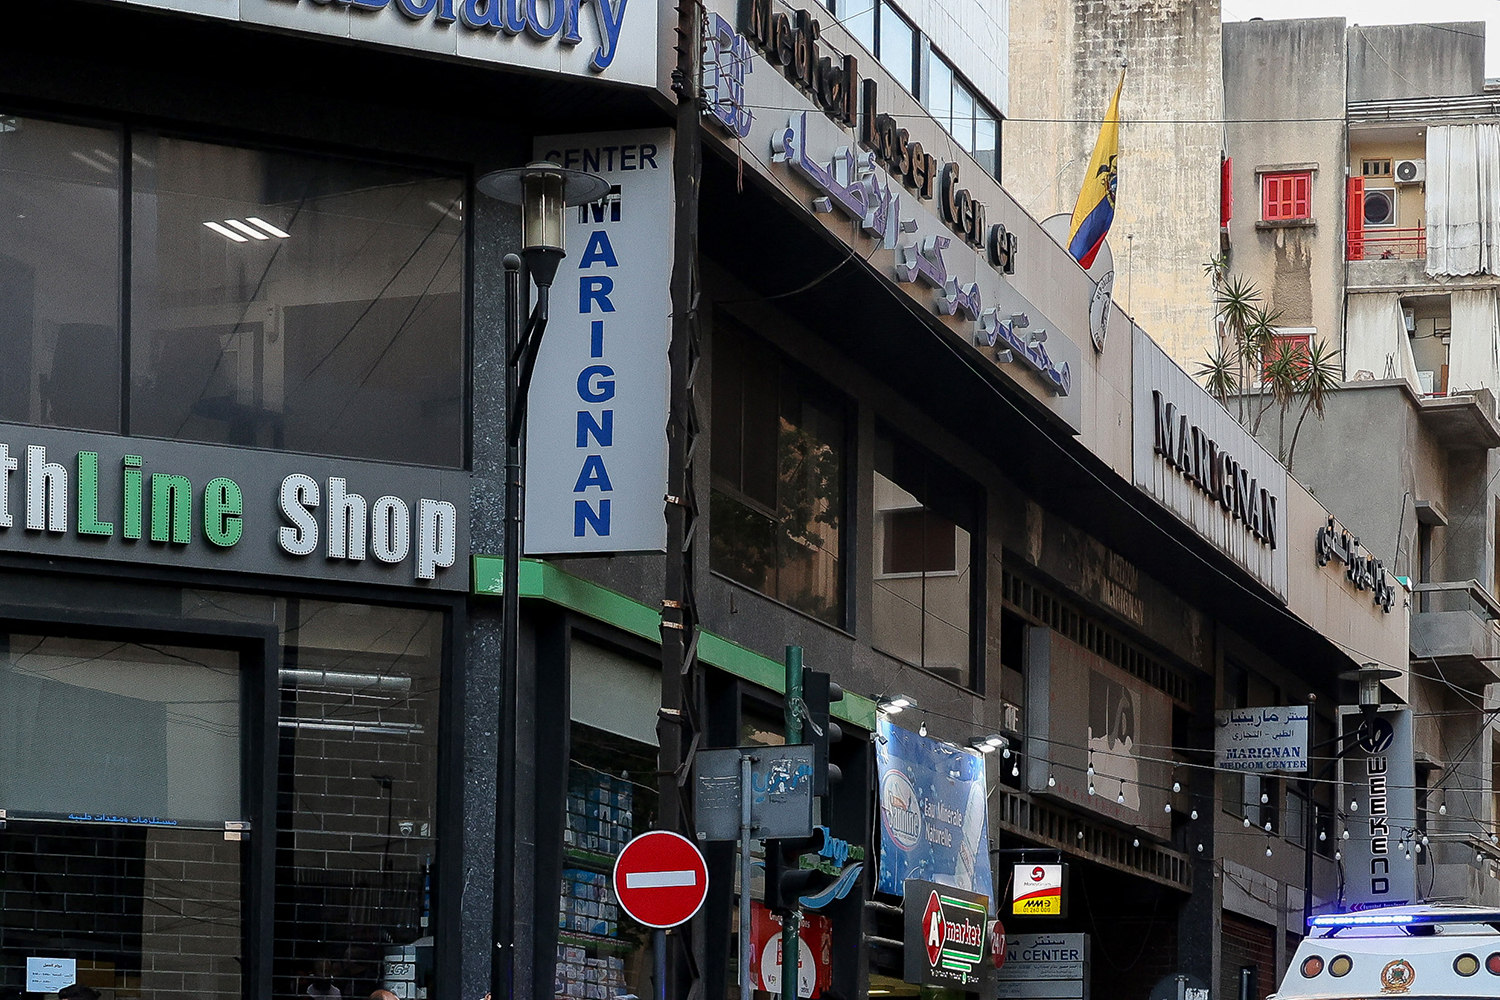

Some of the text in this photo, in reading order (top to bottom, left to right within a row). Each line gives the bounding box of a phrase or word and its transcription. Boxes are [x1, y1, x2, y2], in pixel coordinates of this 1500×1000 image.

[545, 144, 659, 173] CENTER
[572, 184, 622, 539] MARIGNAN
[1152, 389, 1279, 551] MARIGNAN
[277, 473, 458, 580] Shop
[1226, 746, 1301, 760] MARIGNAN
[1266, 760, 1307, 769] CENTER
[1367, 756, 1390, 895] WEEKEND
[946, 917, 982, 948] market
[1029, 936, 1066, 949] سنتر
[1022, 949, 1080, 962] CENTER
